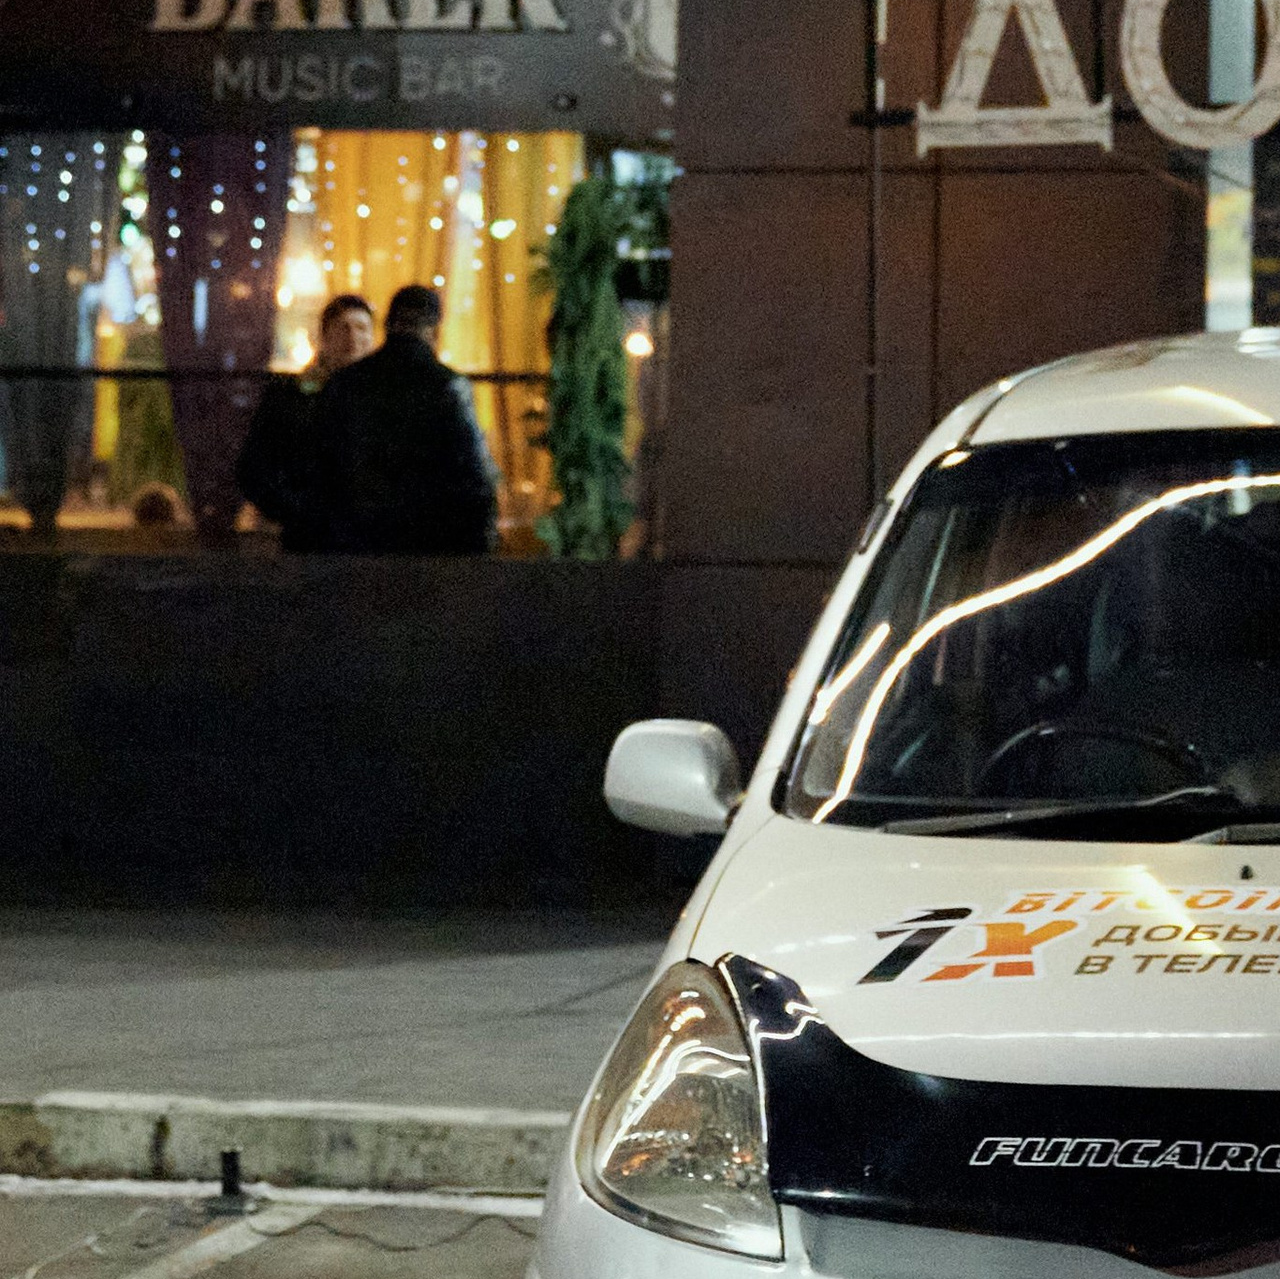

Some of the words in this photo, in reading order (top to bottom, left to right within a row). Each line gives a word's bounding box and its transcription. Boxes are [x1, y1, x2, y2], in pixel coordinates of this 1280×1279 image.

[212, 54, 385, 103] MUSIC
[401, 53, 506, 103] BAR
[1074, 953, 1115, 975] В
